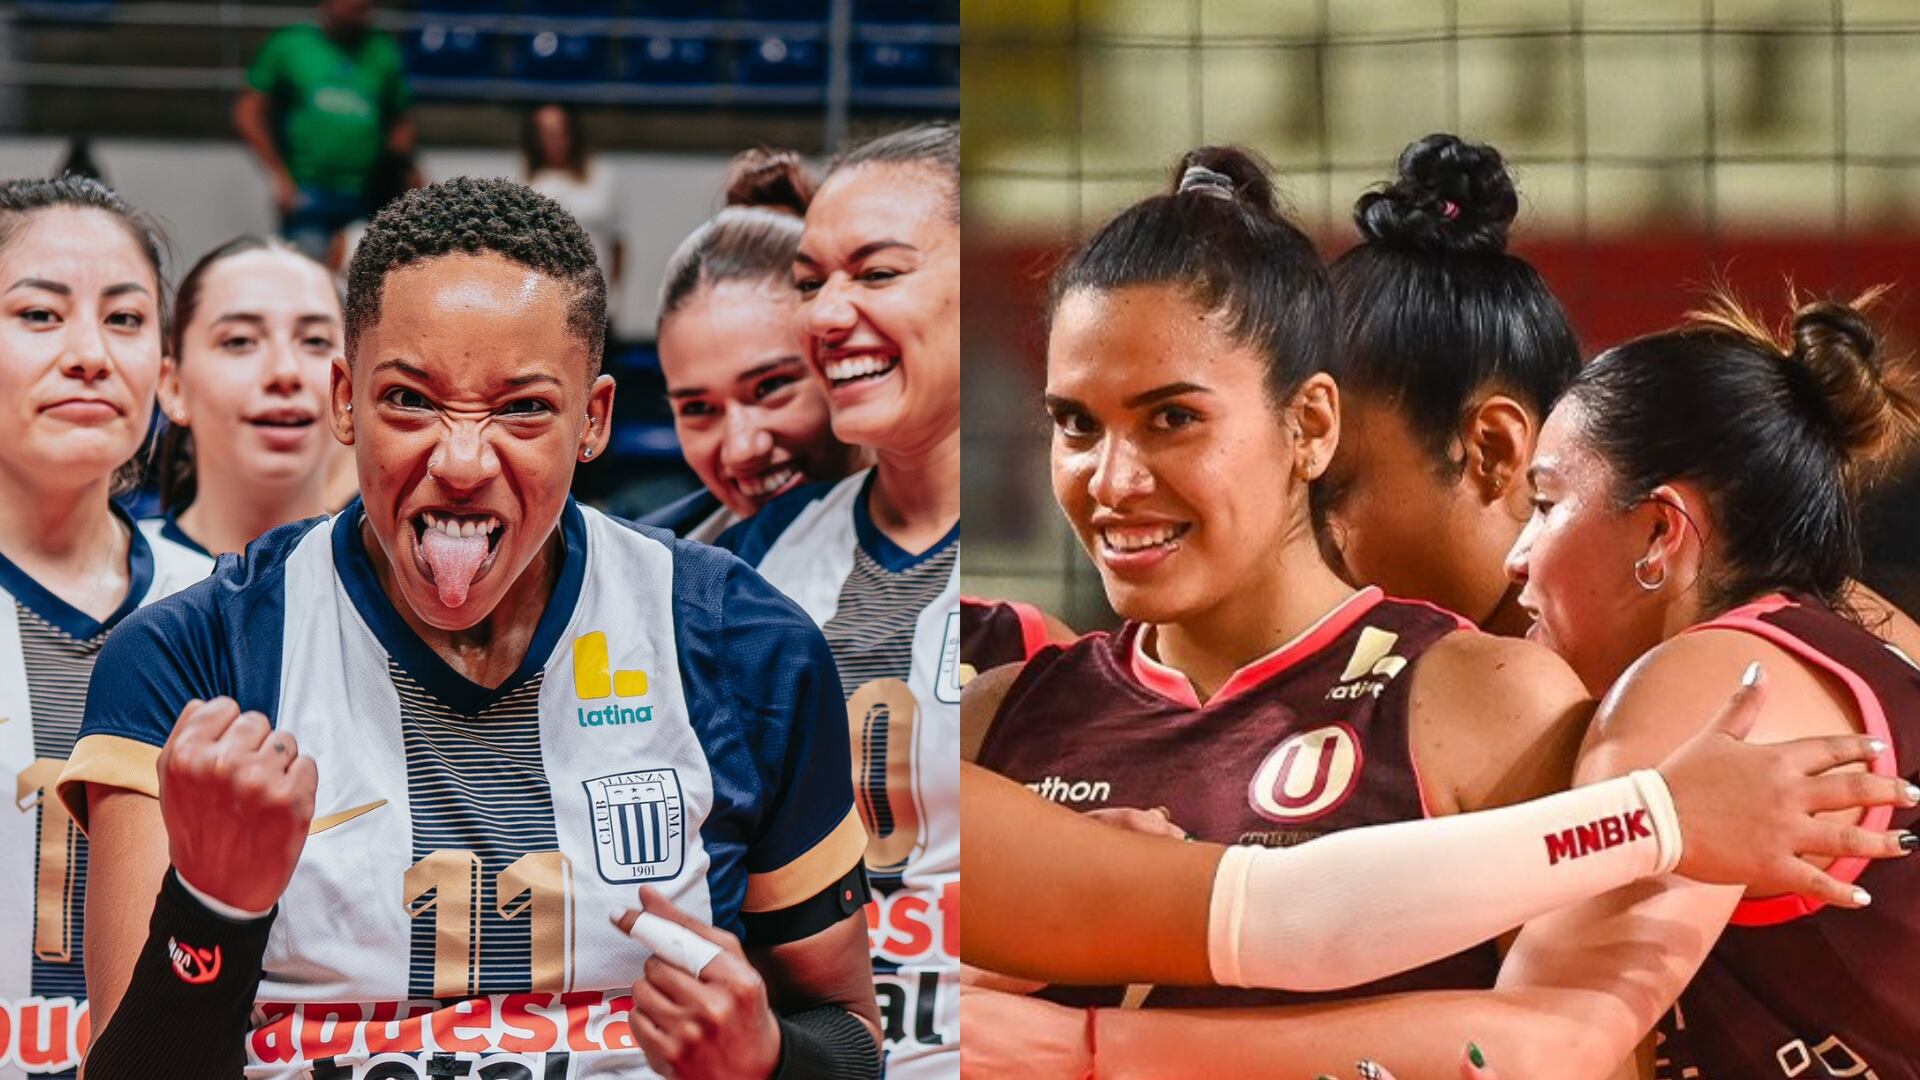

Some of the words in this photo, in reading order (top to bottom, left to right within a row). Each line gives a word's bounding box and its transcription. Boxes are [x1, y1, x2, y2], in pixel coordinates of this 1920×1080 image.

[577, 704, 653, 728] latina
[598, 772, 667, 787] ALIANZA
[1271, 735, 1339, 809] U
[596, 799, 612, 845] CLUB
[666, 795, 680, 839] LIMA
[1543, 811, 1652, 866] MNBK
[631, 865, 656, 877] 1901
[403, 850, 576, 996] 11
